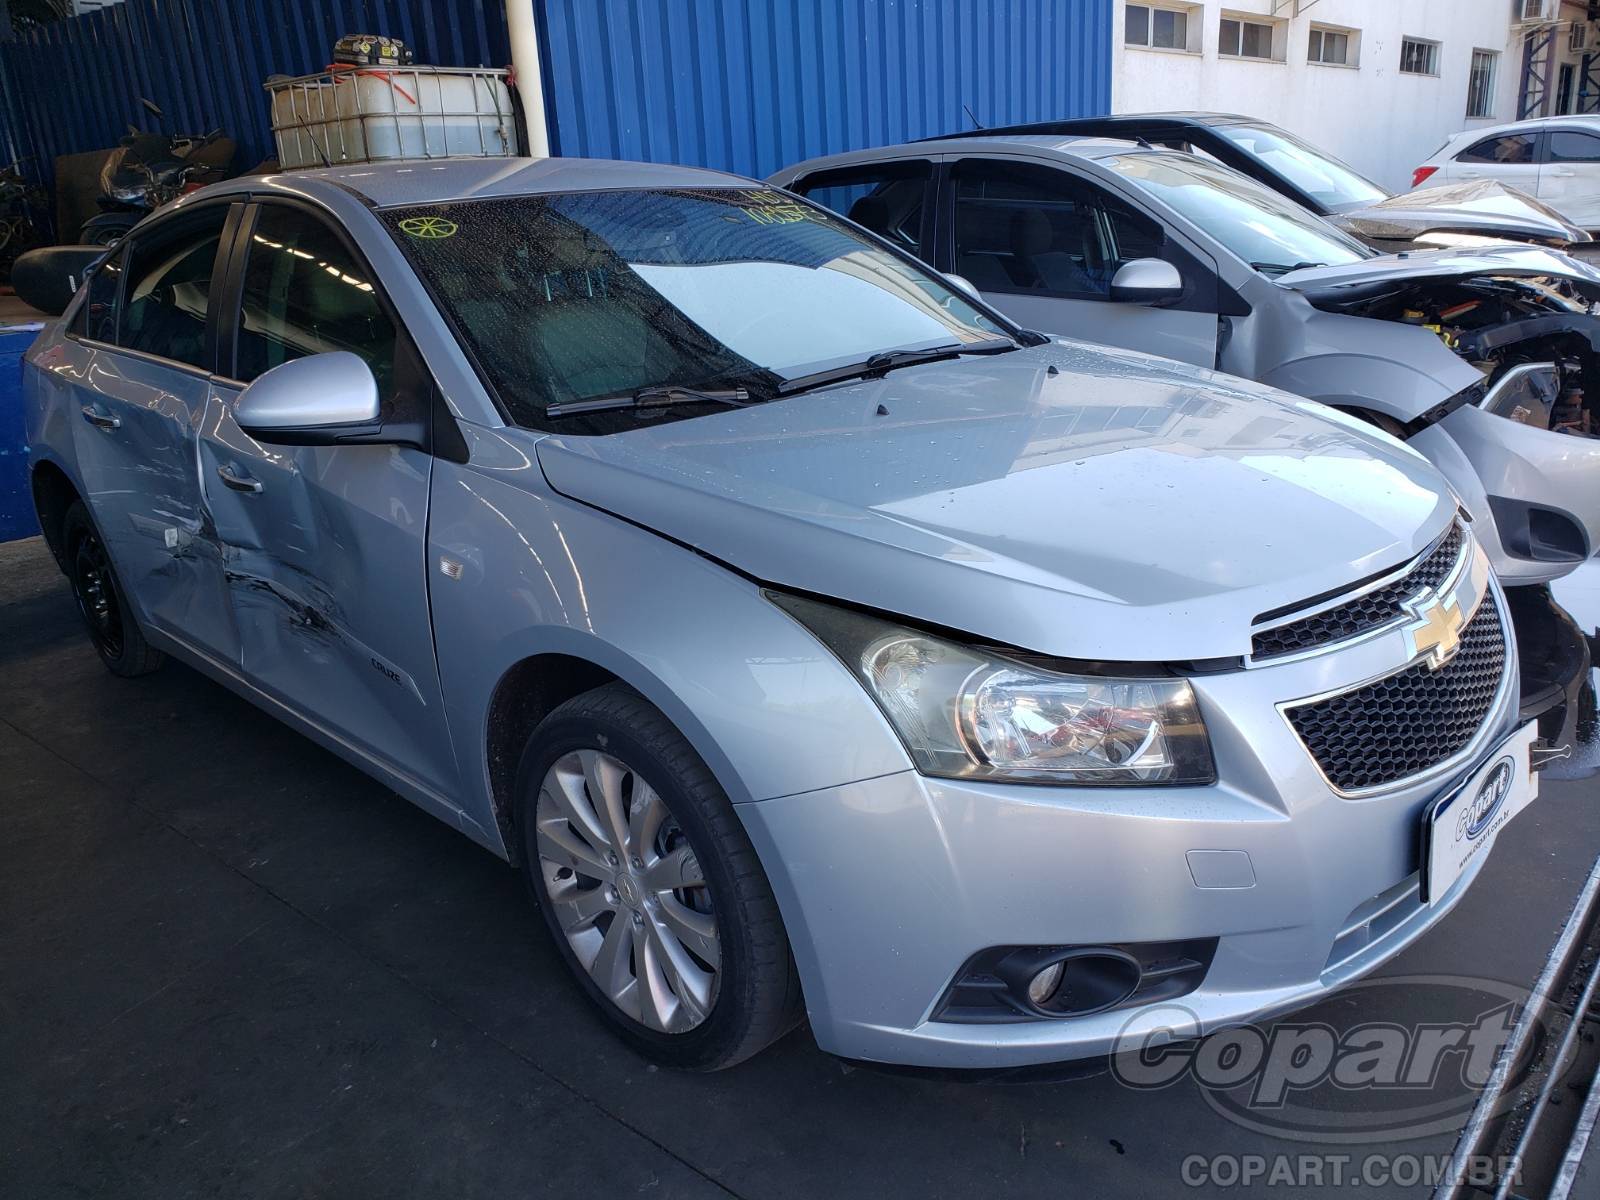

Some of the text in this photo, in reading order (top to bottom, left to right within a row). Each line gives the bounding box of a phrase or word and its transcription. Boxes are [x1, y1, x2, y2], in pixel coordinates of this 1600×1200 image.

[370, 657, 402, 684] CRUZE
[1455, 762, 1508, 843] Copart
[1458, 809, 1510, 869] www.copart.com.br
